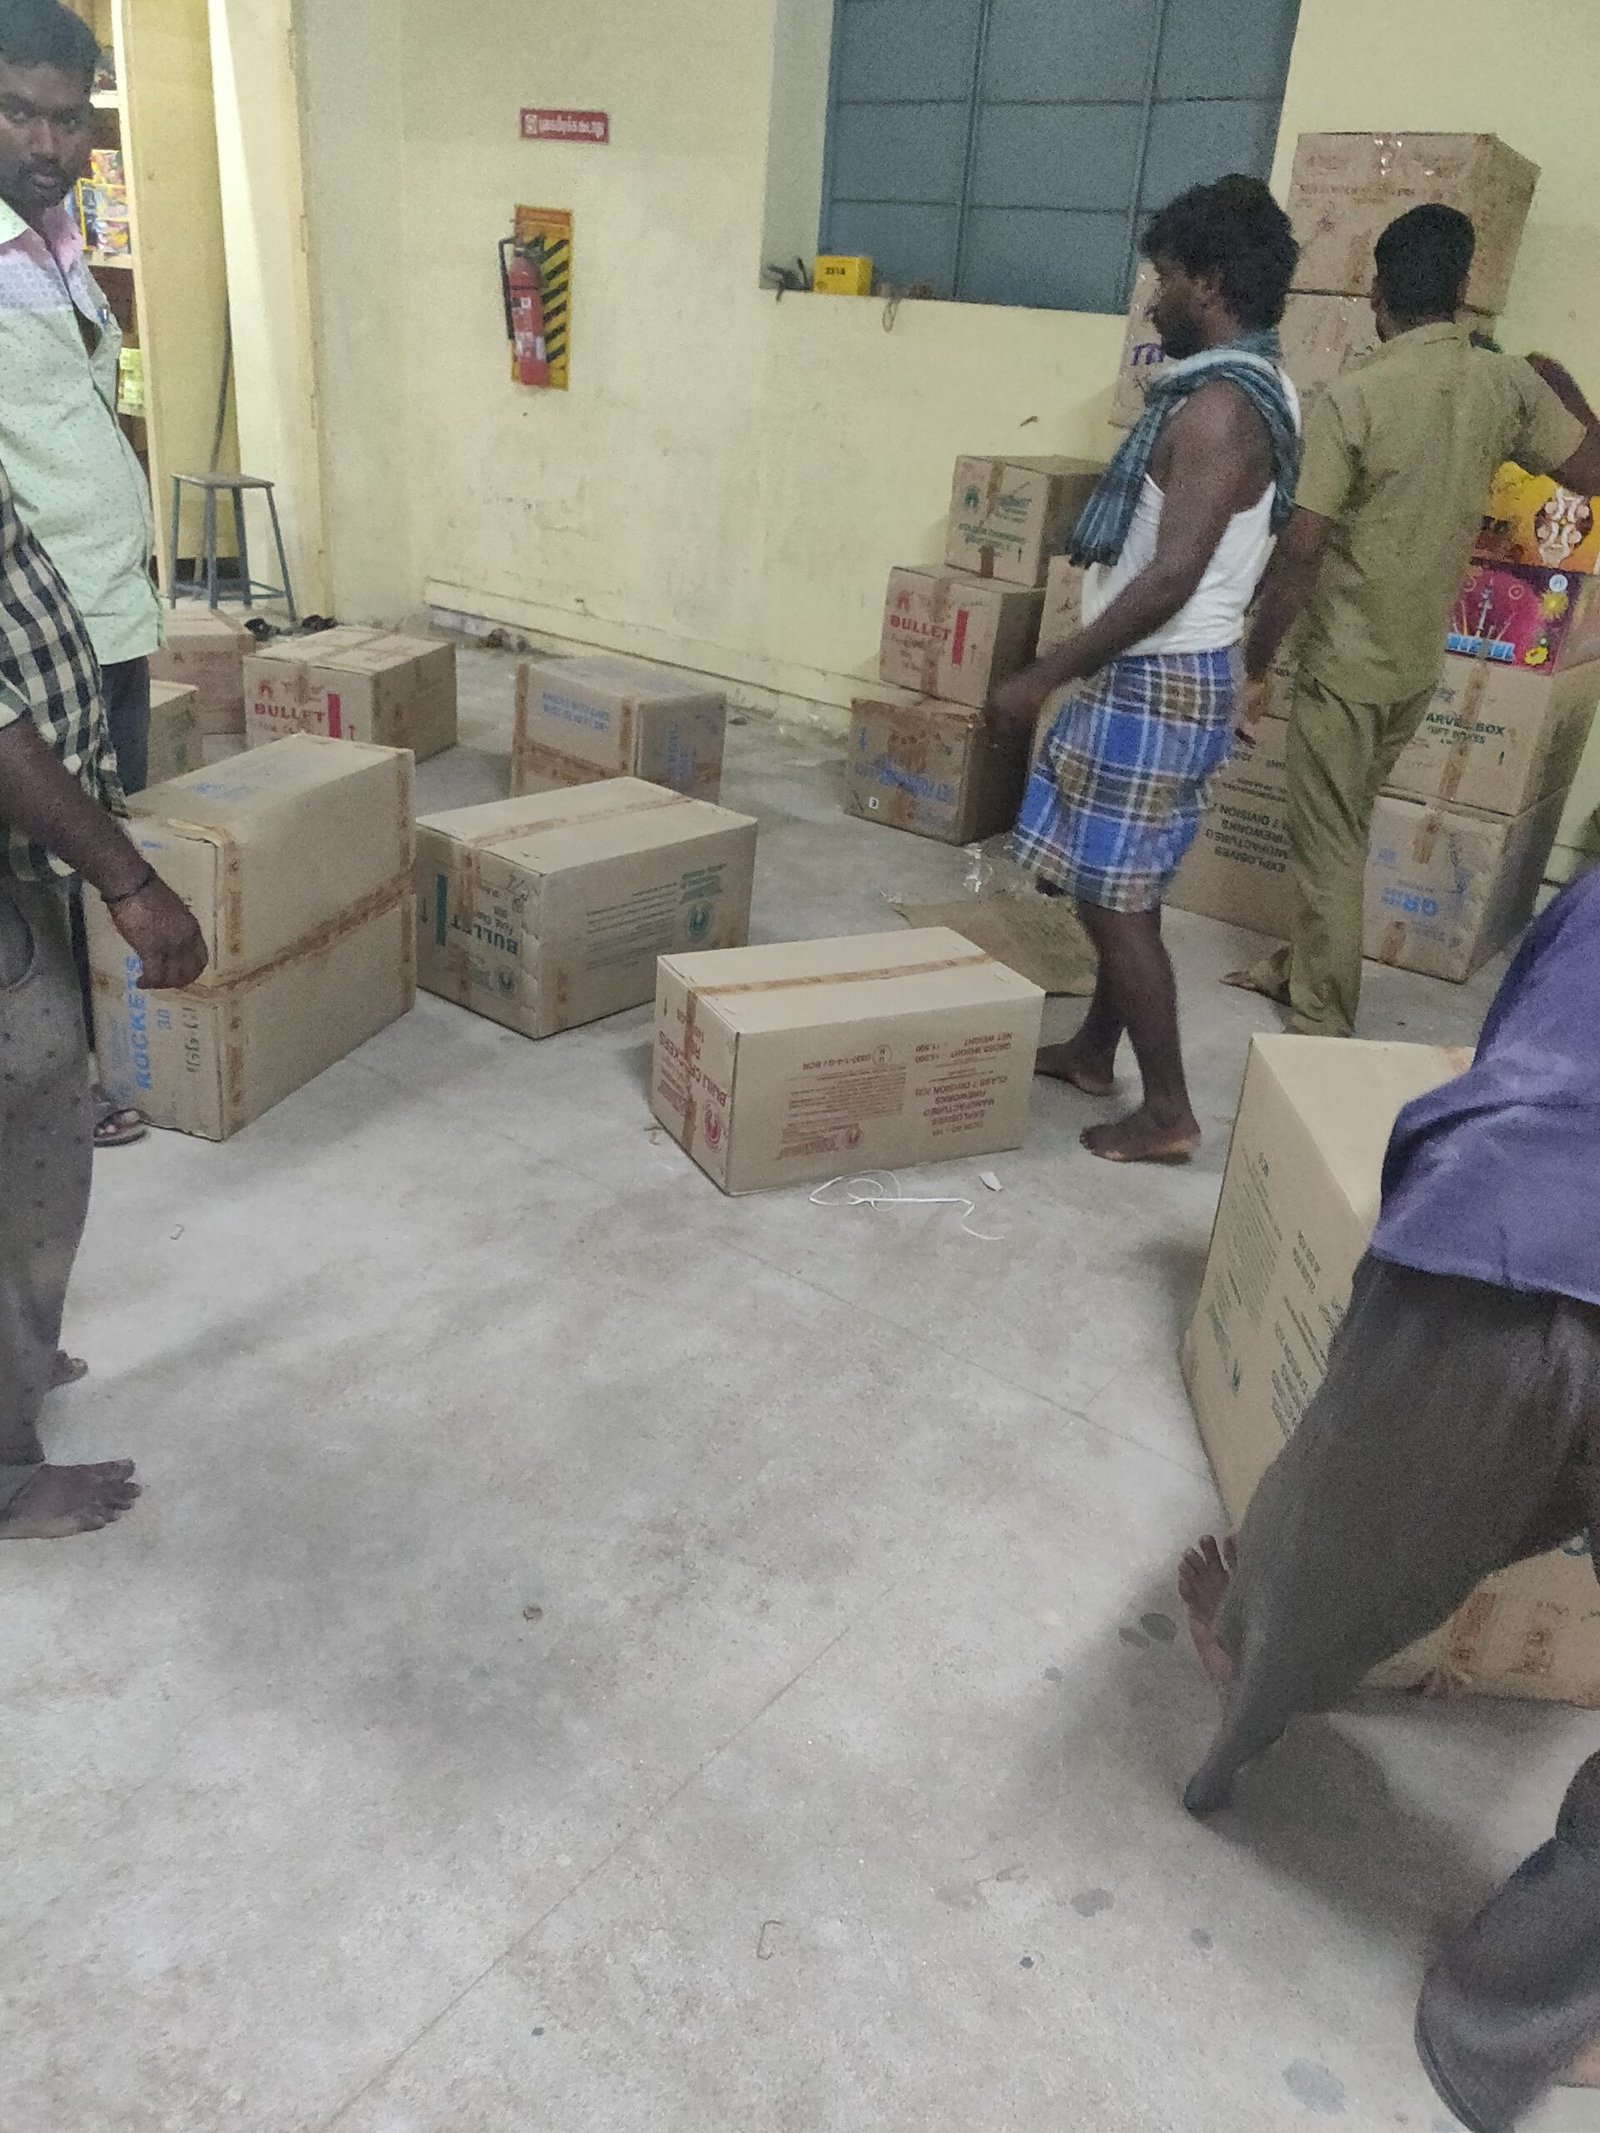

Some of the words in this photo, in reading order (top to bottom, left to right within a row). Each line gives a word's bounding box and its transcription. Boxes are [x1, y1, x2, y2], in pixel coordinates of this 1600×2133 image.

[889, 614, 952, 640] BULLET
[254, 703, 326, 723] BULLET
[1425, 712, 1472, 729] ARVE
[1475, 722, 1506, 736] BOX
[1214, 846, 1286, 873] EXPLOSIVES
[124, 956, 152, 1090] ROCKETS
